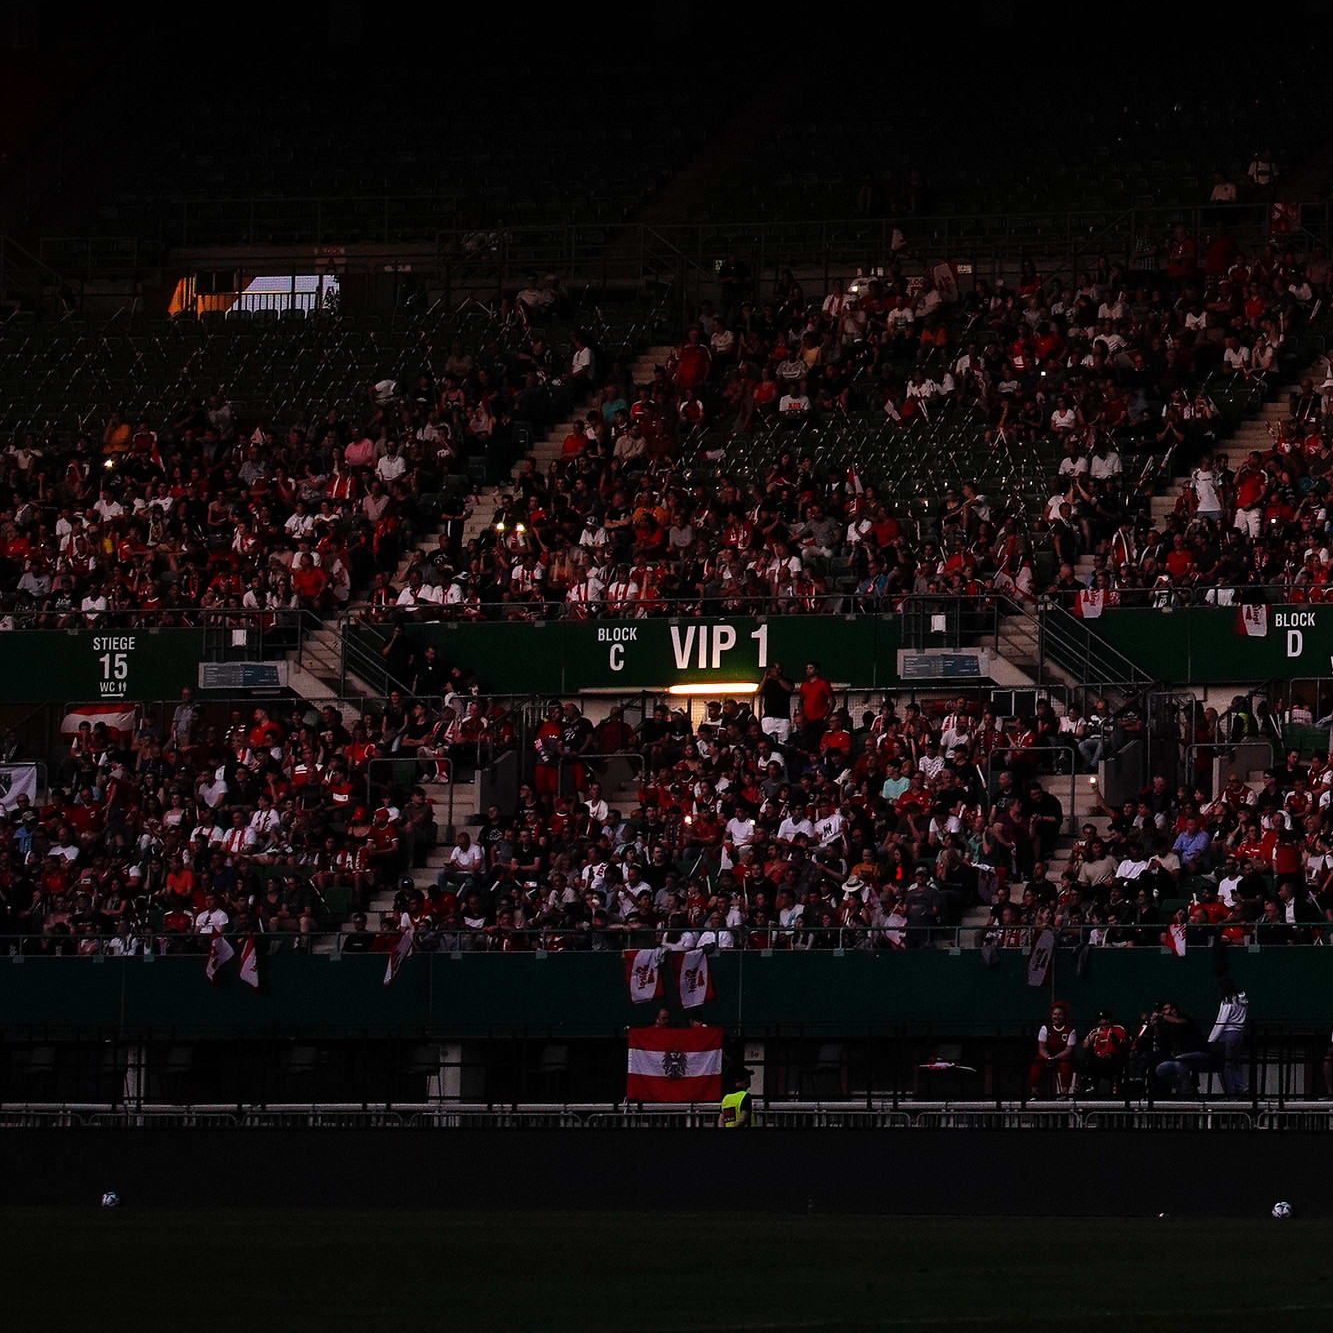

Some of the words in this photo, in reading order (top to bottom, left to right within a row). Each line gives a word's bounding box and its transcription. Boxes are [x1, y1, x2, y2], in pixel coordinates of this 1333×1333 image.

[1275, 612, 1316, 628] BLOCK
[92, 636, 136, 651] STIEGE
[597, 627, 637, 641] BLOCK
[1287, 629, 1304, 658] D
[670, 624, 737, 669] VIP
[750, 623, 768, 668] 1
[99, 653, 128, 679] 15
[609, 643, 625, 671] C
[100, 682, 115, 692] WC
